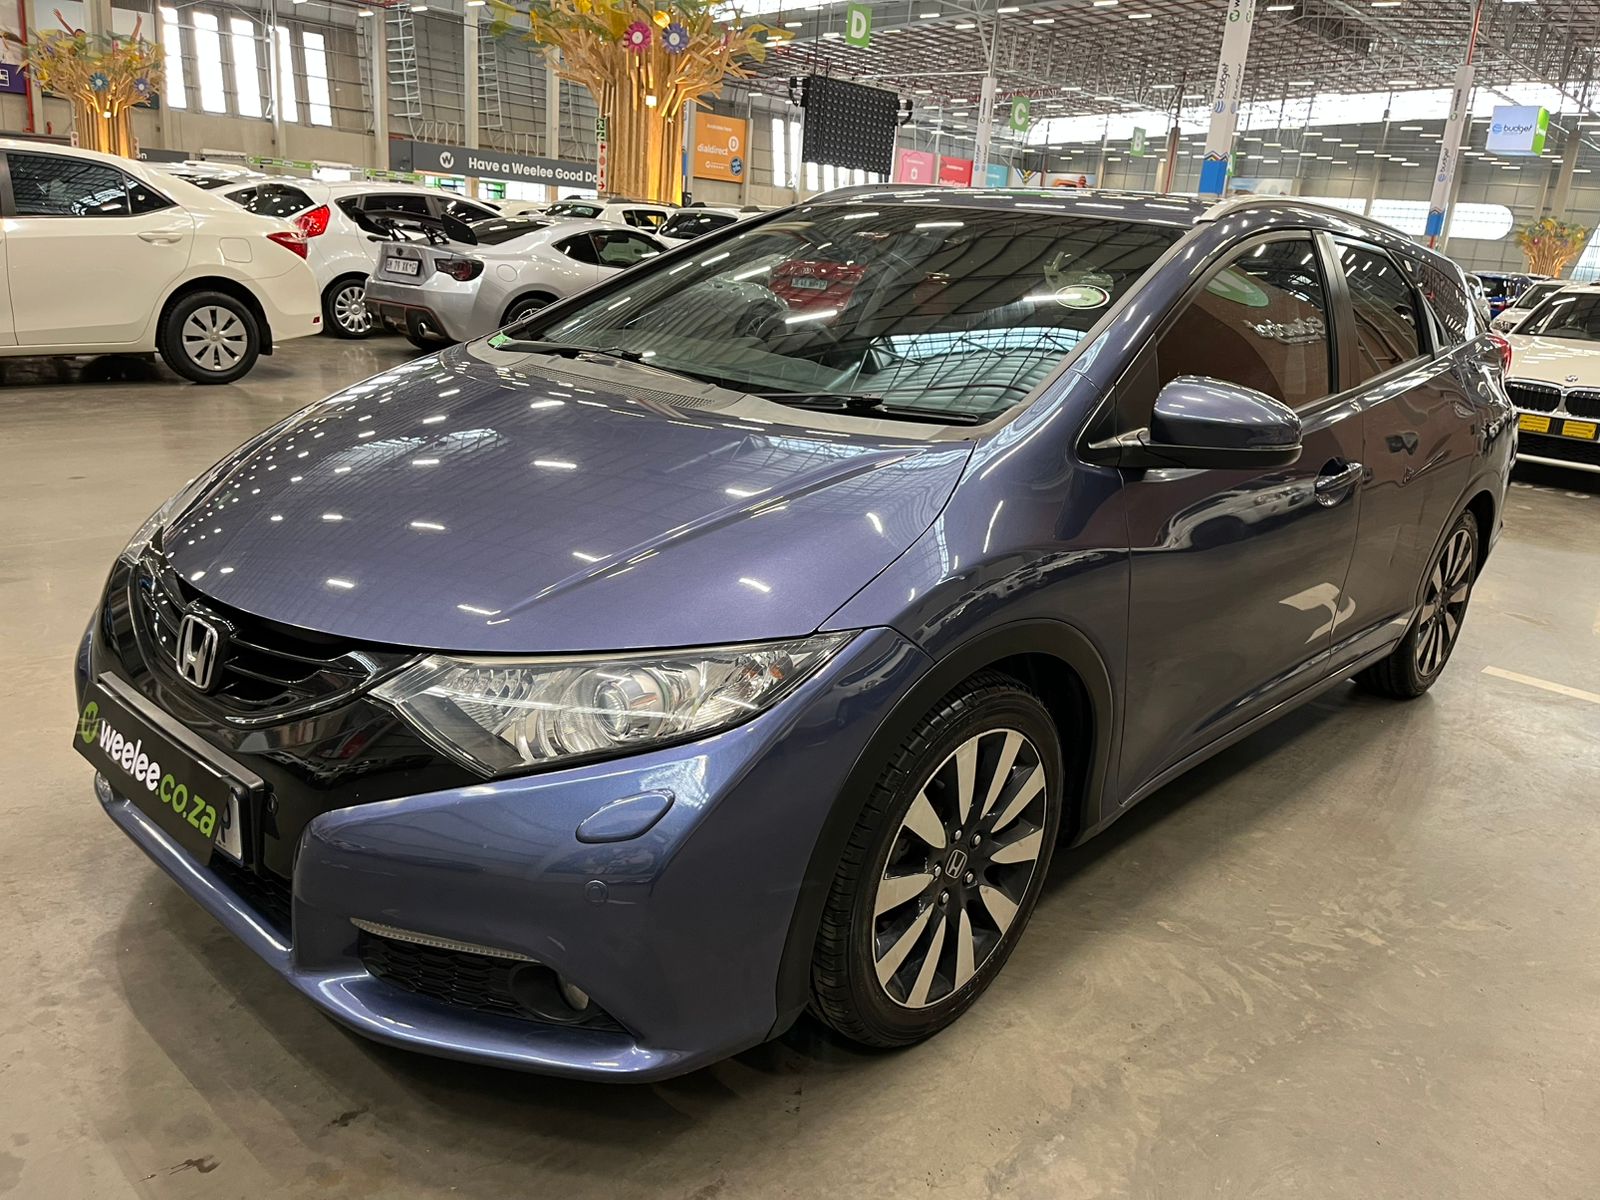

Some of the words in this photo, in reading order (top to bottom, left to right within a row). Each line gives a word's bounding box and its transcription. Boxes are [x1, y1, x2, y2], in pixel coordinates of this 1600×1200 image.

[851, 10, 867, 39] D
[1216, 62, 1231, 99] budget
[1015, 103, 1027, 126] C
[1503, 123, 1532, 135] budget
[469, 157, 499, 172] Have
[502, 163, 510, 173] a
[512, 162, 553, 178] Weelee
[555, 168, 583, 182] Good
[100, 719, 217, 838] weelee.co.za
